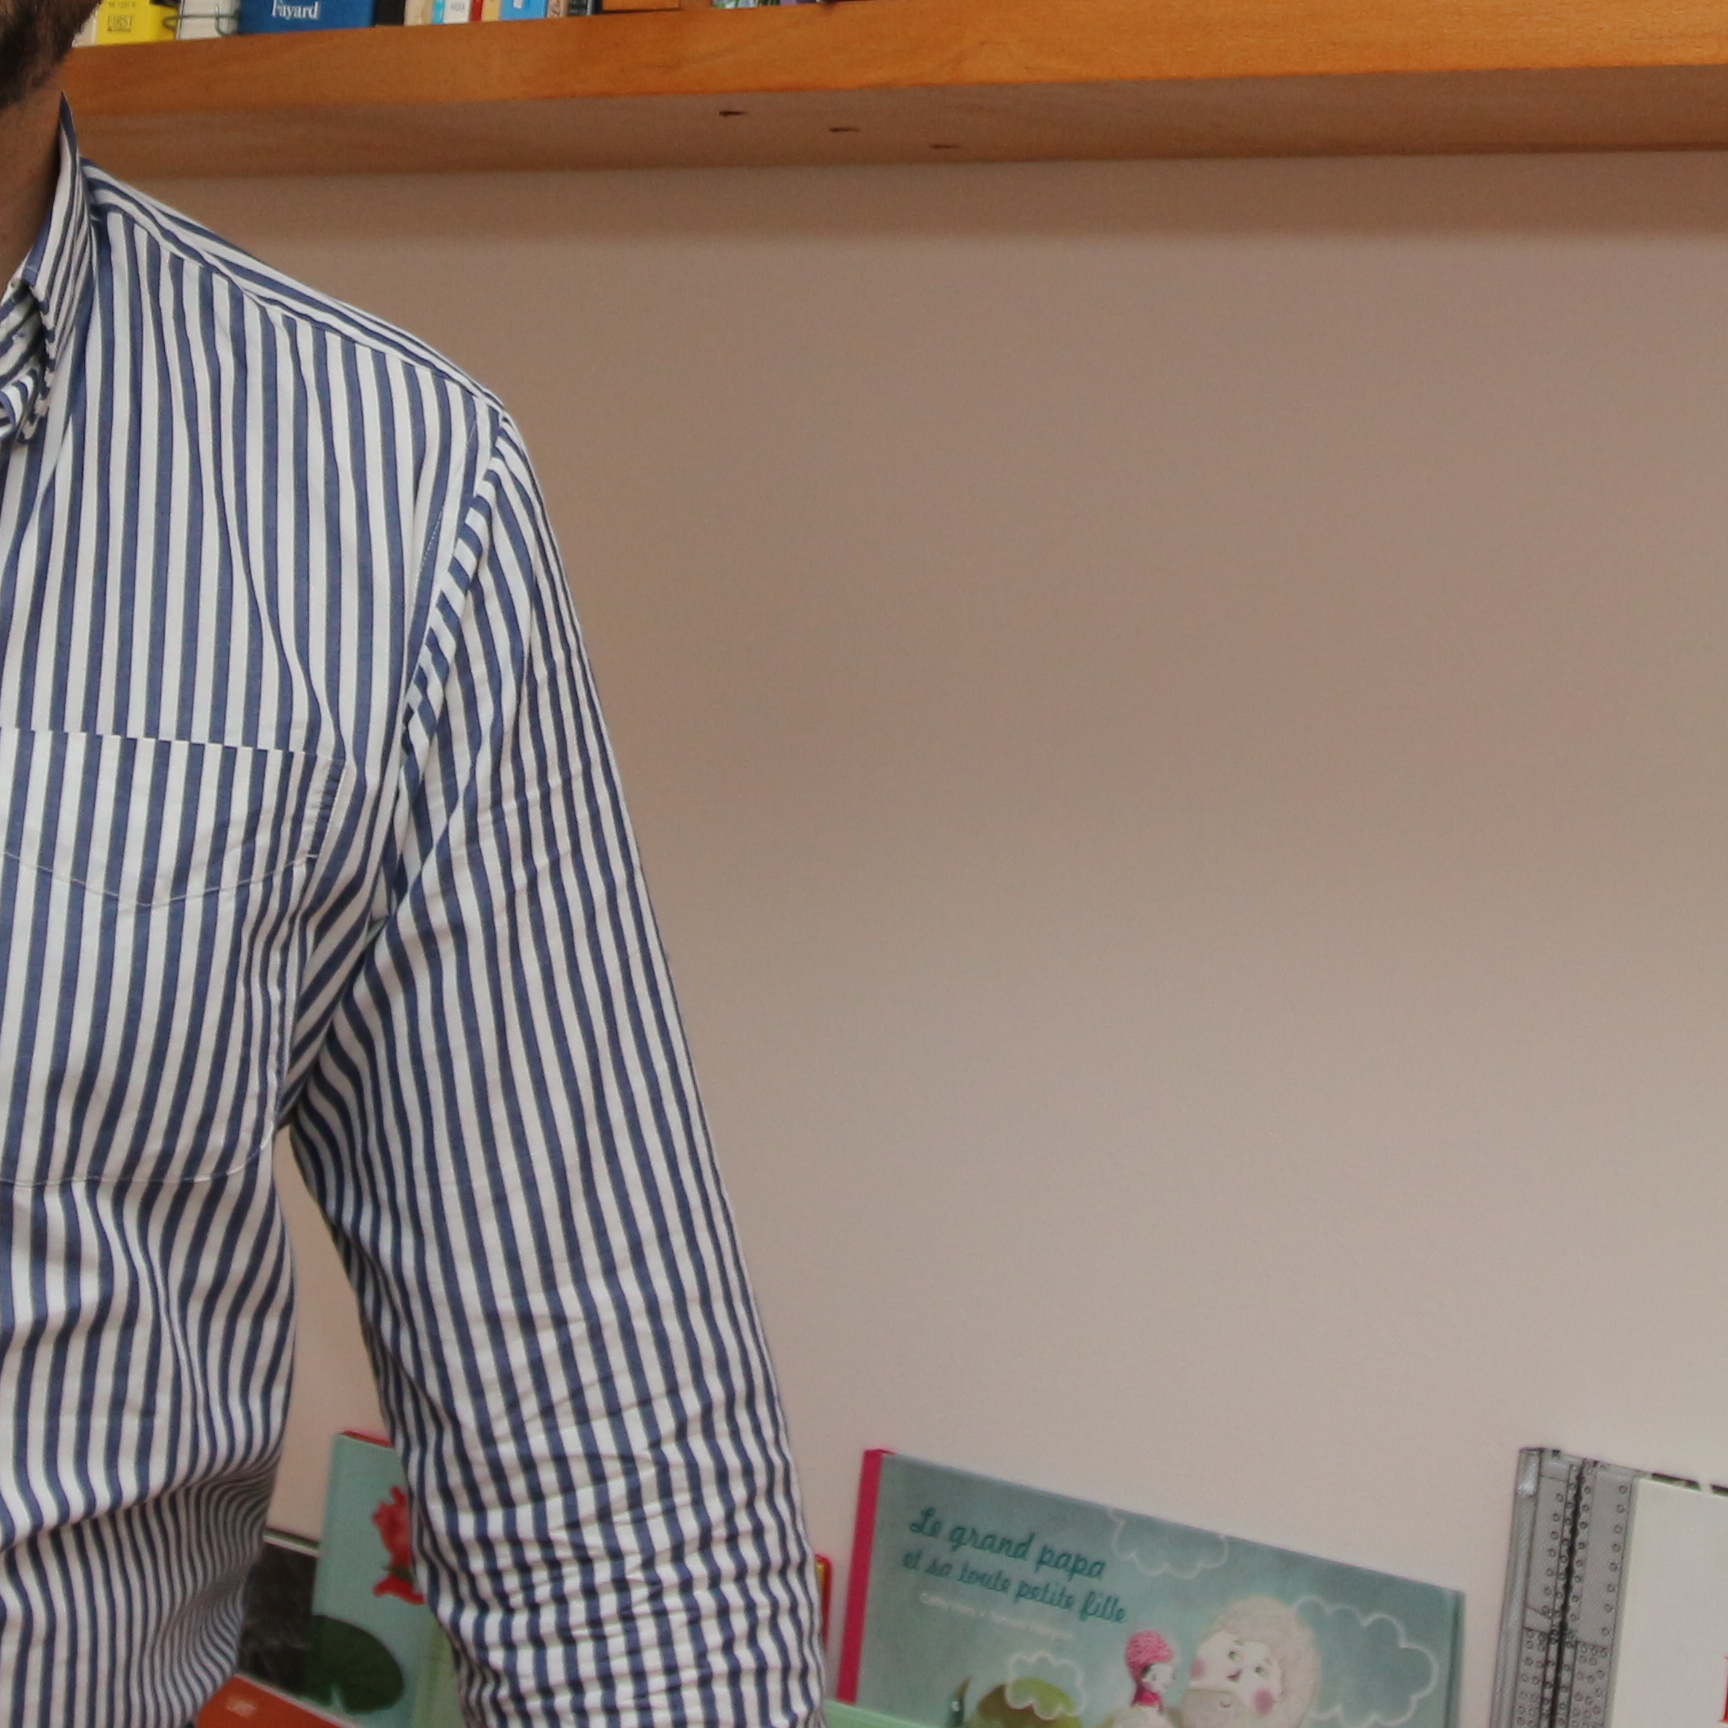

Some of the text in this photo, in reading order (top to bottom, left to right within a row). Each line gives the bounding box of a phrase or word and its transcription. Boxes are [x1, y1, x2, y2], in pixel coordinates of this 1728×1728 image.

[910, 1506, 1107, 1581] Le grand papa
[902, 1550, 921, 1571] et
[925, 1558, 954, 1577] sa
[958, 1557, 1010, 1593] toute
[1014, 1579, 1075, 1611] petite
[1079, 1590, 1127, 1625] fille
